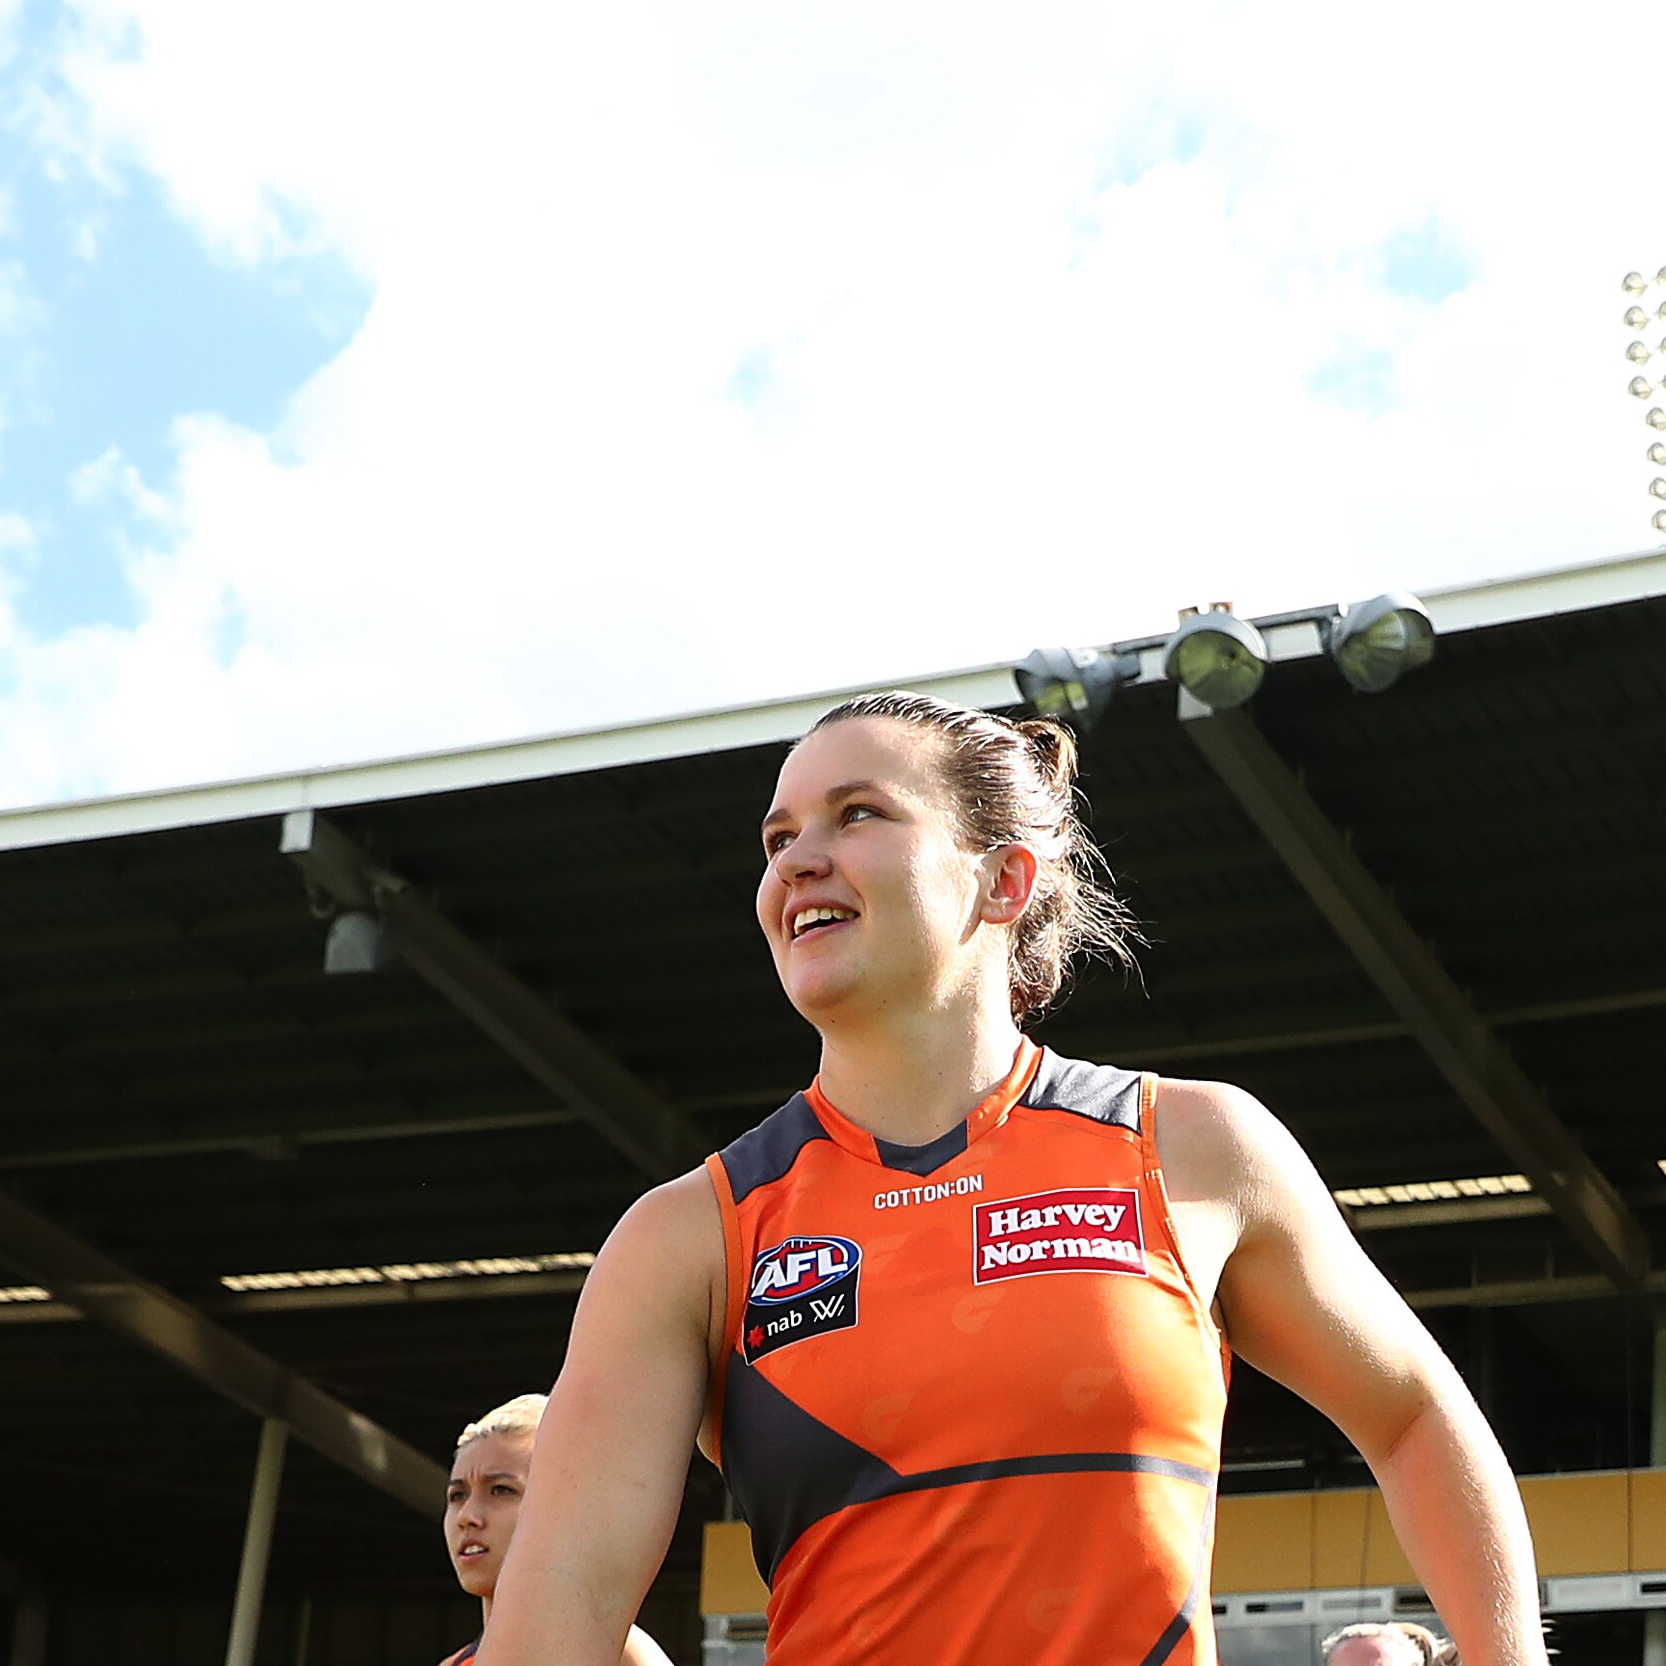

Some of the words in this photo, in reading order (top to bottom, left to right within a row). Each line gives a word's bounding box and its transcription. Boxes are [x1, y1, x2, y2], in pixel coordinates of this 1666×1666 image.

[988, 1201, 1127, 1238] Harvey
[980, 1234, 1142, 1271] Norman
[750, 1246, 849, 1298] AFL
[766, 1309, 803, 1337] nab
